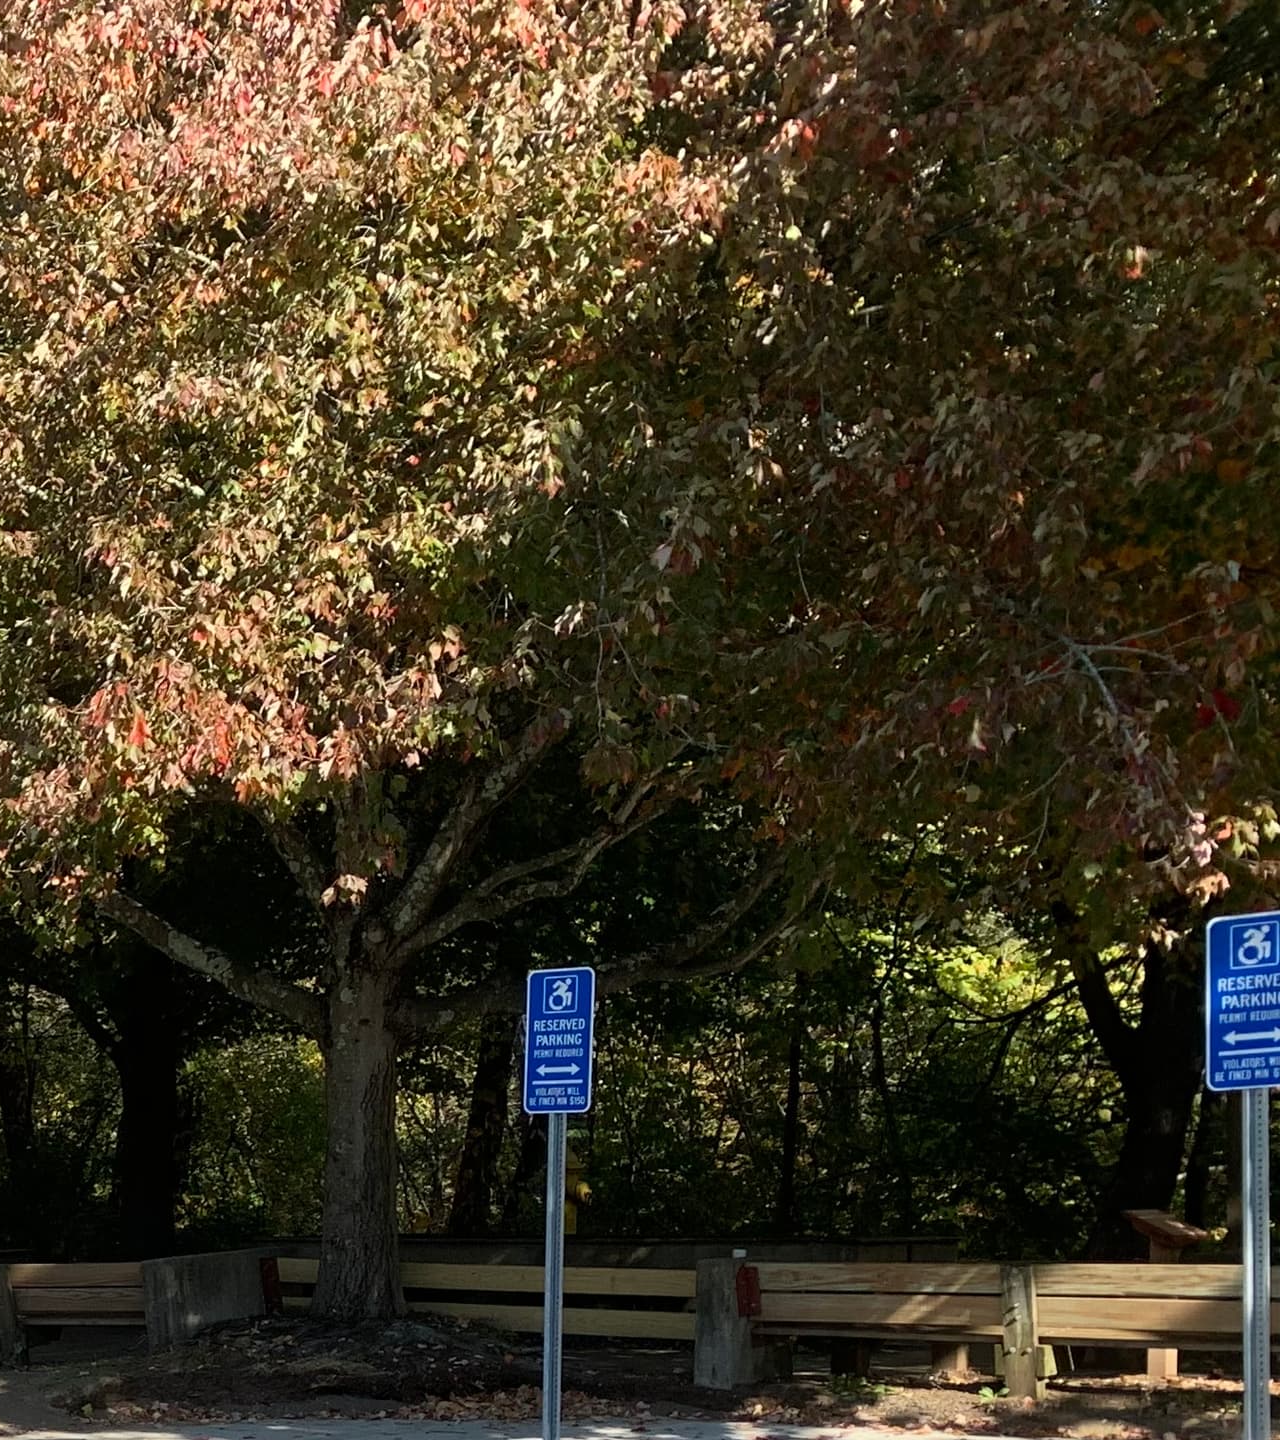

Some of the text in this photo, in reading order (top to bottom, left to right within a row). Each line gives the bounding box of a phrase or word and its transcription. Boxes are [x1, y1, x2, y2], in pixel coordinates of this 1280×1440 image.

[1217, 973, 1280, 992] RESERVE
[1221, 991, 1280, 1010] PARKIN
[1250, 1009, 1280, 1022] REQUIR
[533, 1018, 586, 1032] RESERVED
[536, 1033, 582, 1047] PARKING
